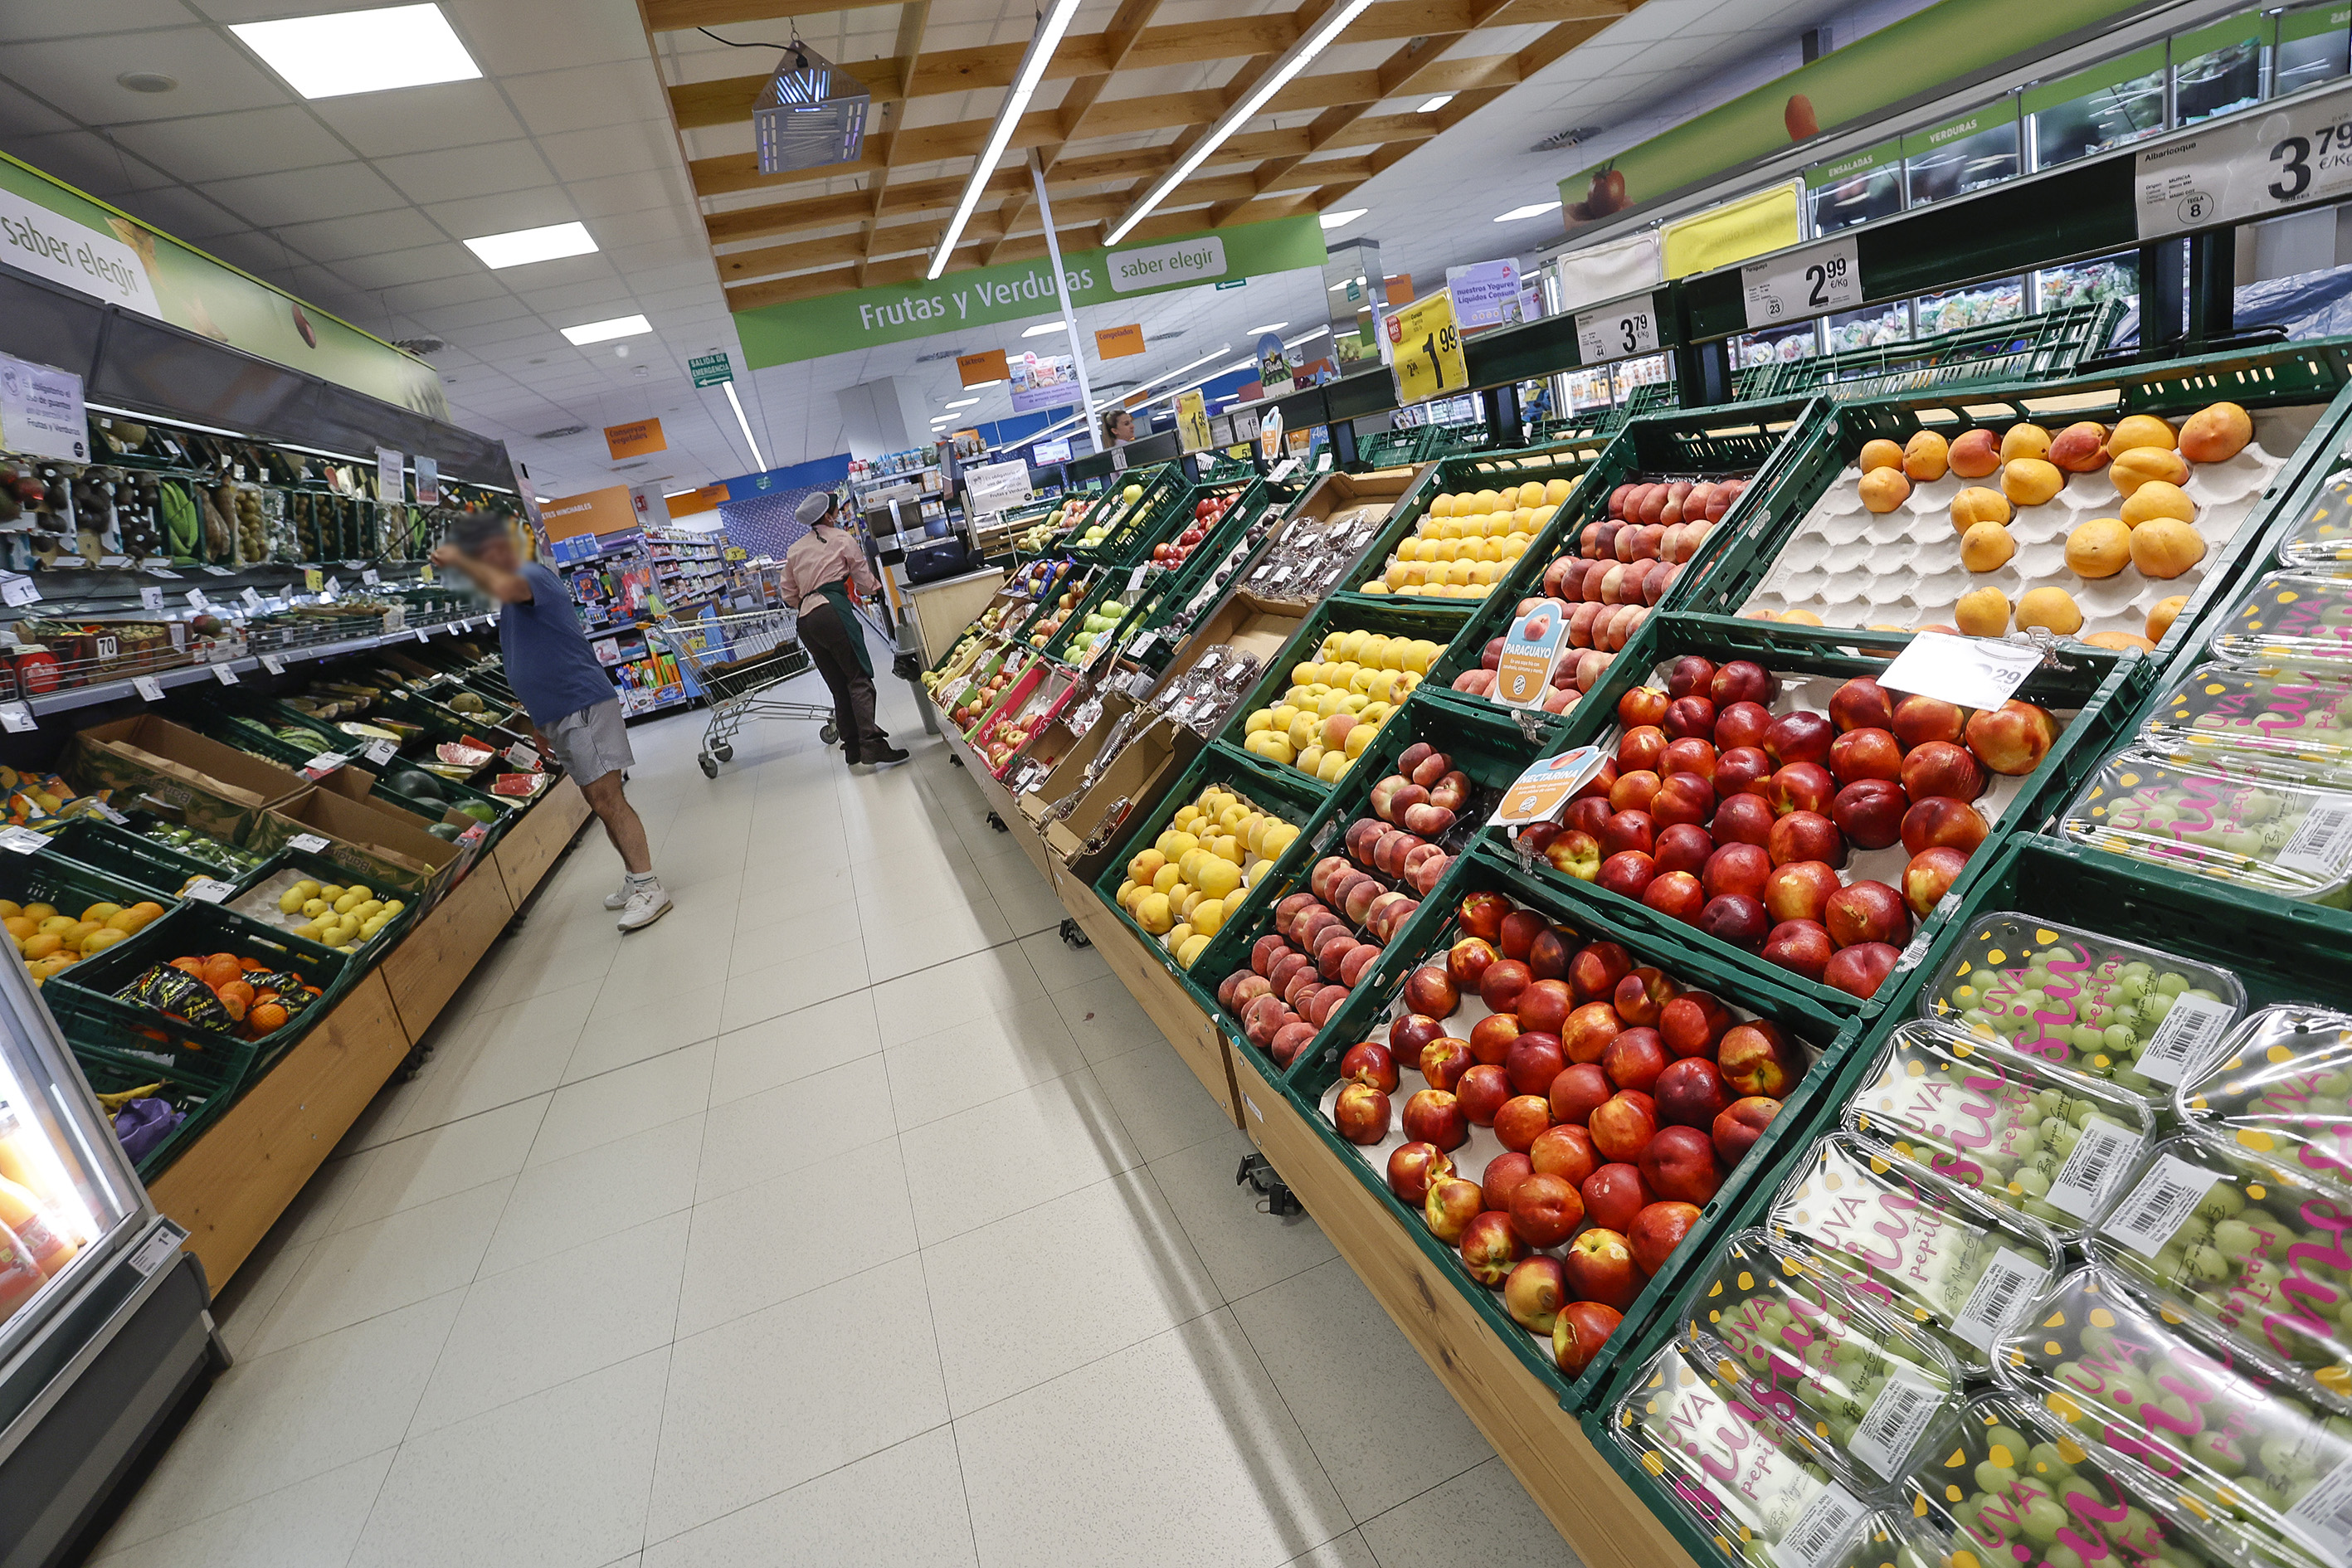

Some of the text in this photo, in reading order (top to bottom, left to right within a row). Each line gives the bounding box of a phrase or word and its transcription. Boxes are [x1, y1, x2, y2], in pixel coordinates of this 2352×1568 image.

[1929, 119, 1977, 144] VERDURAS
[1829, 155, 1873, 178] ENSALADAS
[2145, 141, 2197, 162] Albaricoque
[2267, 121, 2352, 199] 3 79
[2187, 195, 2204, 205] TECLA
[2190, 204, 2202, 217] 8
[1, 216, 139, 296] saber elegir
[1120, 248, 1213, 278] saber elegir
[859, 268, 1094, 330] Frutas y Verduas
[1457, 281, 1514, 295] nuestros Yogures
[1458, 290, 1516, 304] Líquidos Consum
[1805, 257, 1847, 307] 2 99
[1830, 278, 1848, 289] €/Kg
[1770, 304, 1780, 314] 23
[1098, 328, 1134, 340] Congelados
[1596, 348, 1605, 357] 44
[1620, 314, 1648, 353] 3 79
[690, 353, 726, 368] SALIDA DE
[692, 363, 730, 377] EMERGENCIA
[961, 357, 986, 367] Lácteos
[1422, 324, 1458, 389] 1 99
[609, 425, 646, 437] Conservas
[1191, 412, 1202, 447] 1
[1009, 486, 1029, 495] Verduras
[19, 586, 28, 597] 1
[2278, 597, 2330, 636] UVA
[99, 638, 114, 655] 70
[1505, 644, 1551, 658] PARAGUAYO
[2197, 692, 2257, 729] UVA
[982, 725, 996, 740] Pink
[1518, 769, 1580, 784] NECTARINA
[2112, 784, 2168, 830] UVA
[2149, 760, 2228, 864] sin
[1979, 967, 2034, 1018] UVA
[2014, 942, 2091, 1062] sin
[2084, 952, 2125, 1031] pepitas
[1899, 1081, 1951, 1135] UVA
[1931, 1056, 2007, 1188] sin
[1999, 1069, 2038, 1157] pepitas
[1813, 1195, 1867, 1251] UVA
[1841, 1175, 1920, 1307] sin
[1909, 1190, 1950, 1283] pepitas
[2217, 1226, 2277, 1332] pepitas
[1722, 1297, 1776, 1355] UVA
[1750, 1279, 1827, 1422] sin
[2064, 1338, 2149, 1394] UVA
[1657, 1391, 1715, 1449] UVA
[2104, 1342, 2233, 1478] sin
[1675, 1400, 1765, 1521] sin
[1965, 1480, 2047, 1548] UVA
